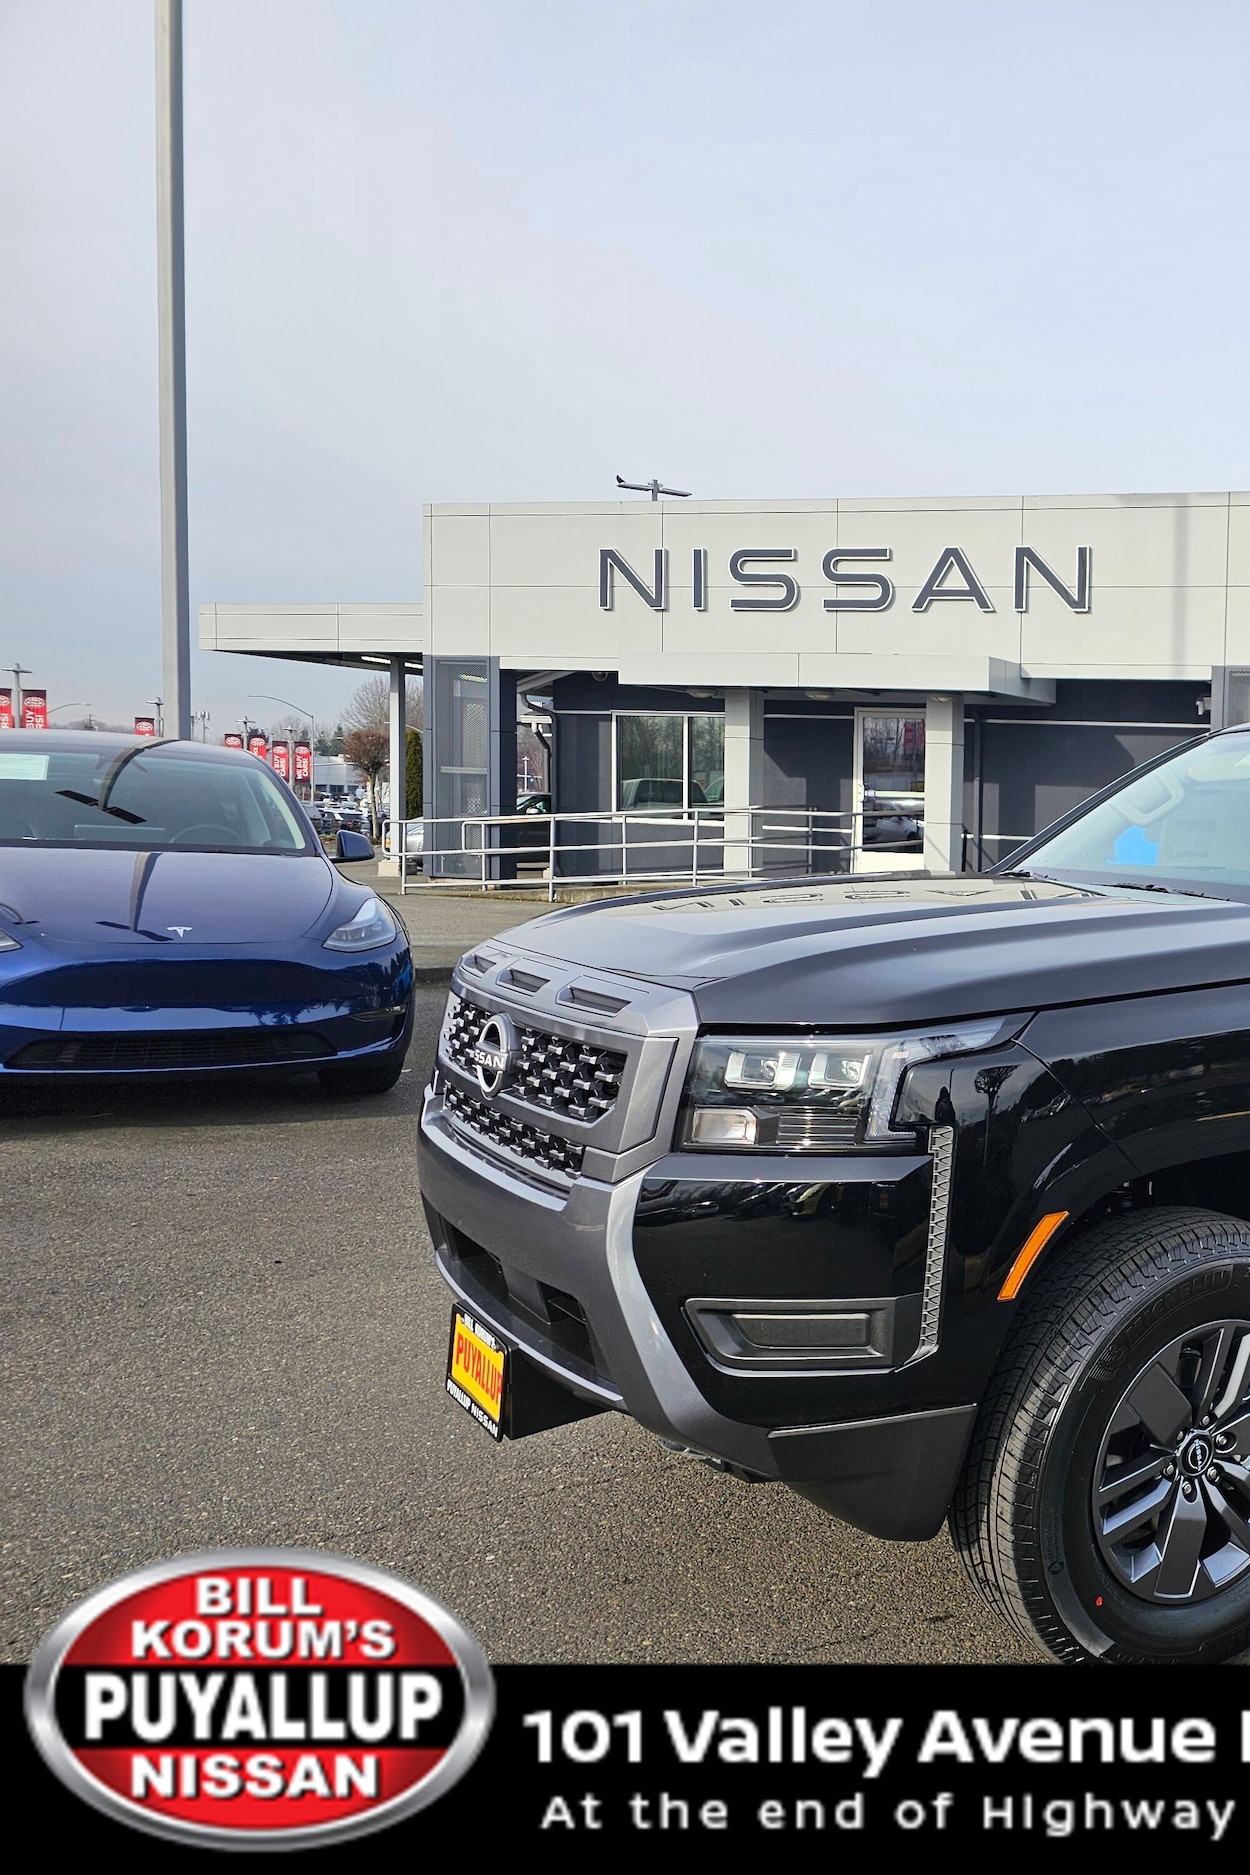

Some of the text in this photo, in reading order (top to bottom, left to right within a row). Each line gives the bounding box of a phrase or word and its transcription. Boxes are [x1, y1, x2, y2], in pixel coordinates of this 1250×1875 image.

[599, 546, 1092, 612] NISSAN
[456, 1332, 503, 1405] PUYALLUP
[471, 1402, 498, 1437] NISSAN
